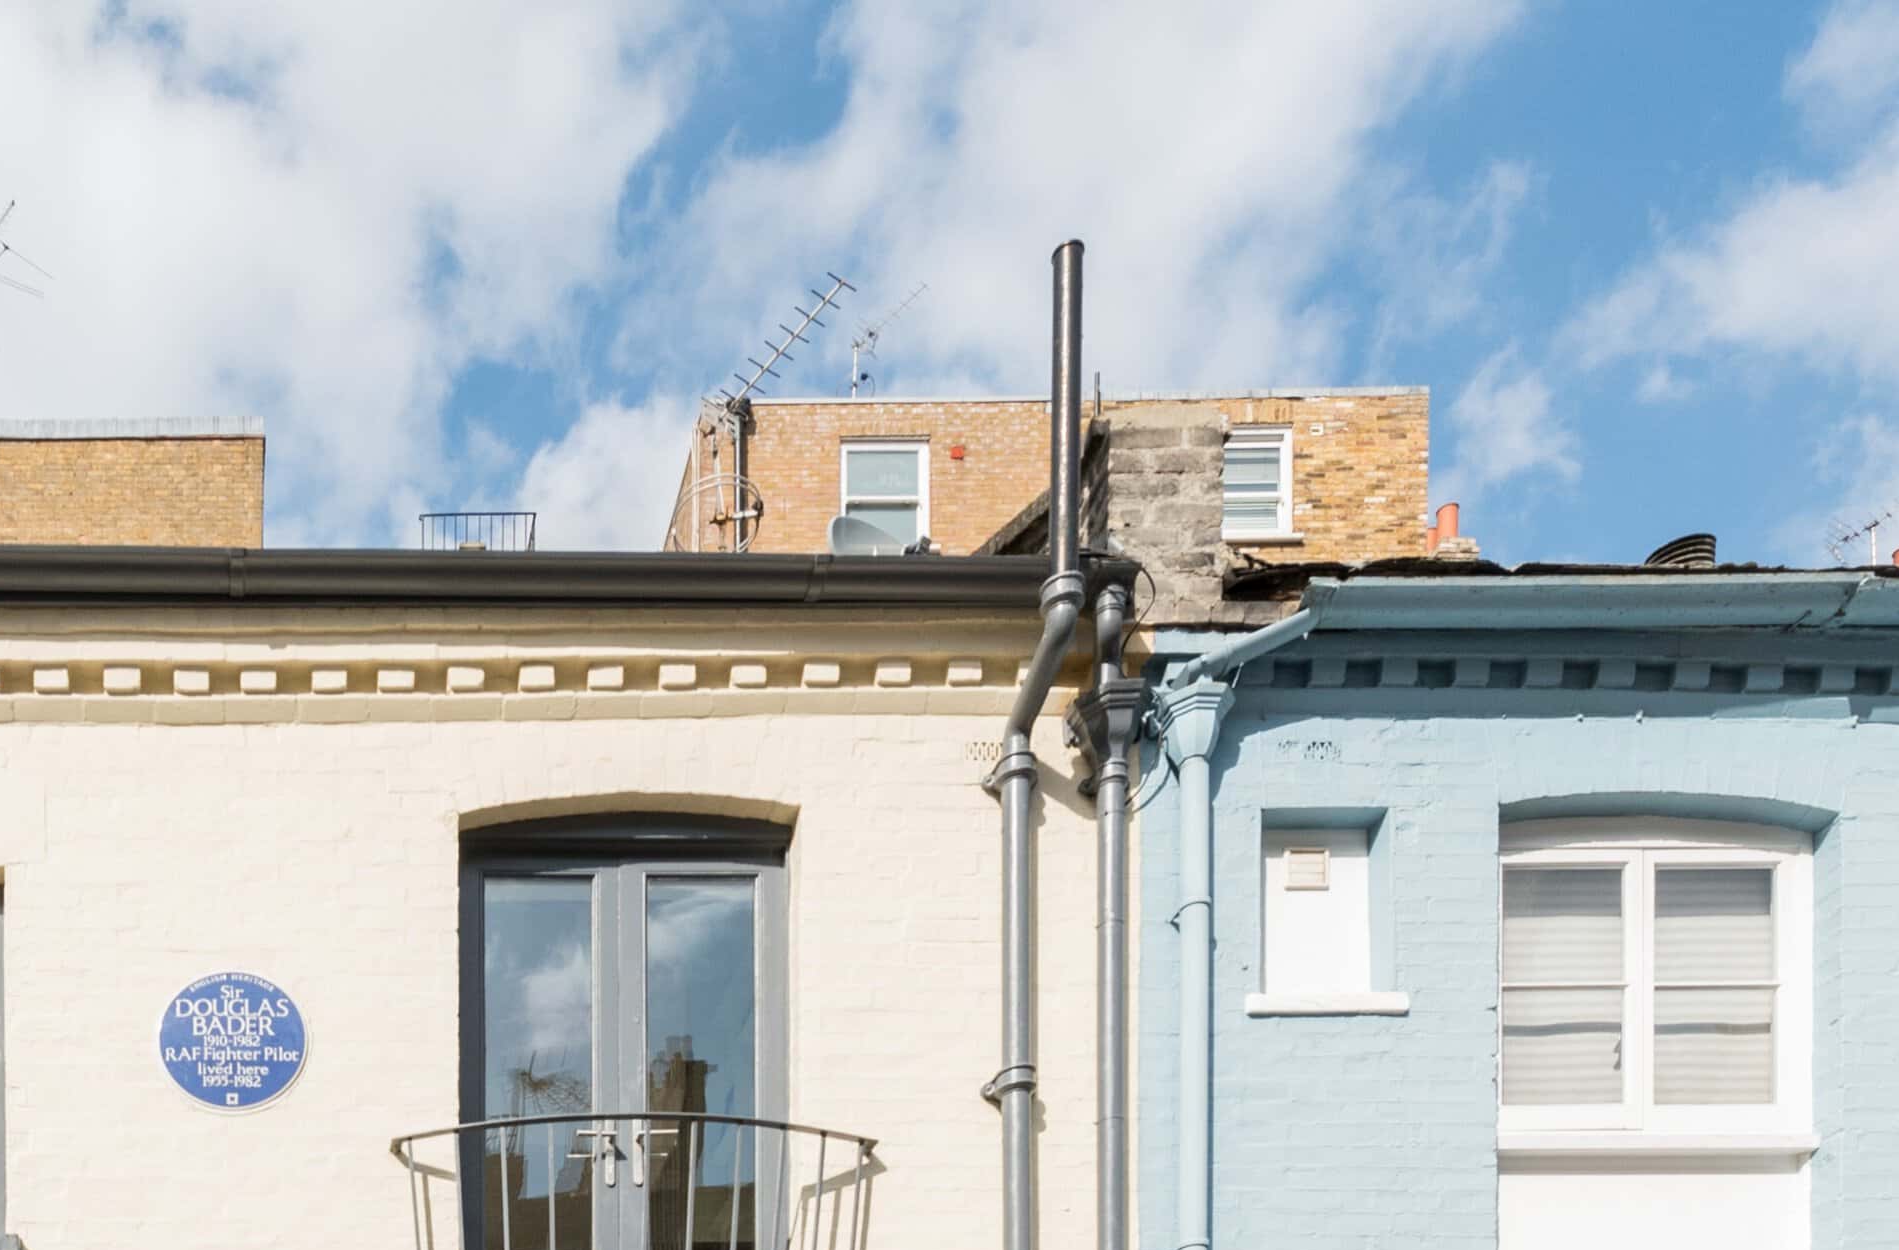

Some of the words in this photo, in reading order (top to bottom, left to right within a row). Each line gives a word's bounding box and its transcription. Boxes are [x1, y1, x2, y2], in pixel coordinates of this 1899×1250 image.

[189, 974, 227, 993] ENGLISH
[230, 974, 275, 993] HERITAGE
[219, 985, 244, 999] Sir
[175, 998, 289, 1017] DOUGLAS
[192, 1016, 275, 1036] BADER
[203, 1035, 261, 1047] 1910-1982
[165, 1047, 200, 1062] RAF
[203, 1047, 261, 1066] Fighter
[263, 1046, 300, 1062] Pilot
[197, 1062, 233, 1075] lived
[236, 1062, 269, 1075] here
[202, 1075, 262, 1088] 1955-1982
